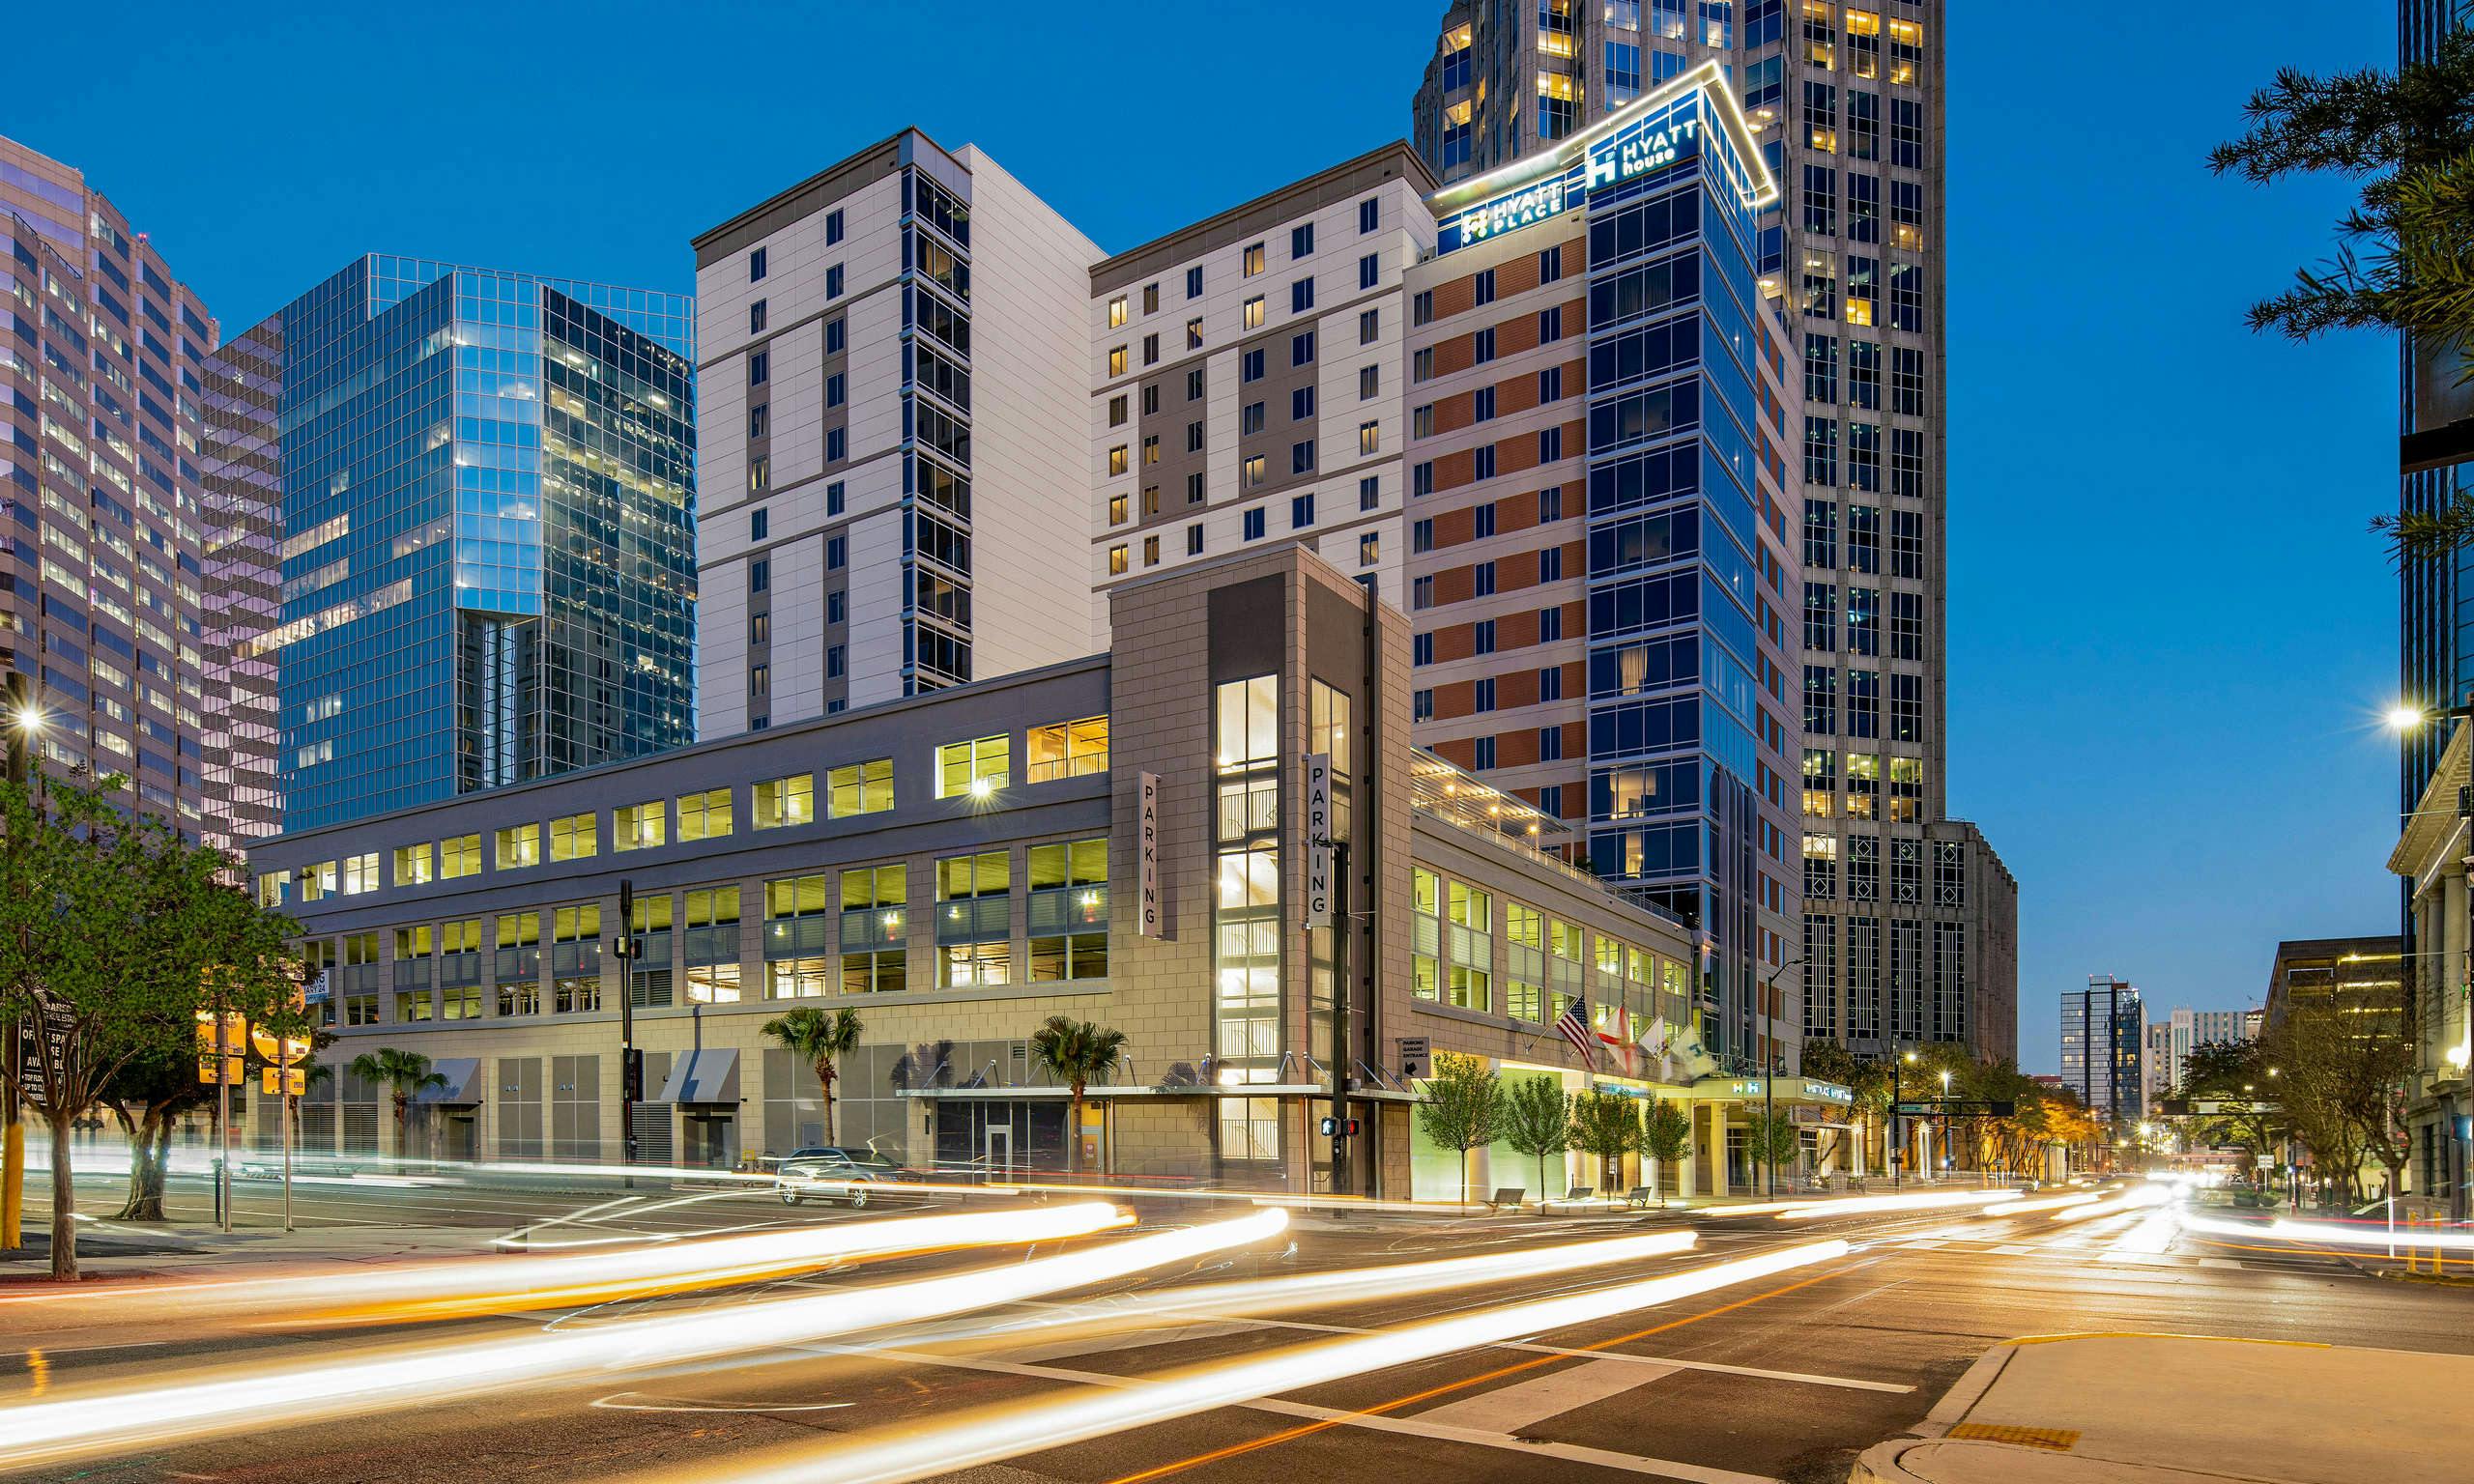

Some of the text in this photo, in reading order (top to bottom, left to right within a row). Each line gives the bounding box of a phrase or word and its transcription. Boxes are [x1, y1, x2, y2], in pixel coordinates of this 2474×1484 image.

[1623, 119, 1697, 161] HYATT
[1623, 148, 1676, 176] house
[1493, 181, 1563, 220] HYATT
[1493, 198, 1562, 234] PLACE
[1144, 785, 1155, 925] PARKING
[1312, 768, 1325, 913] PARKING
